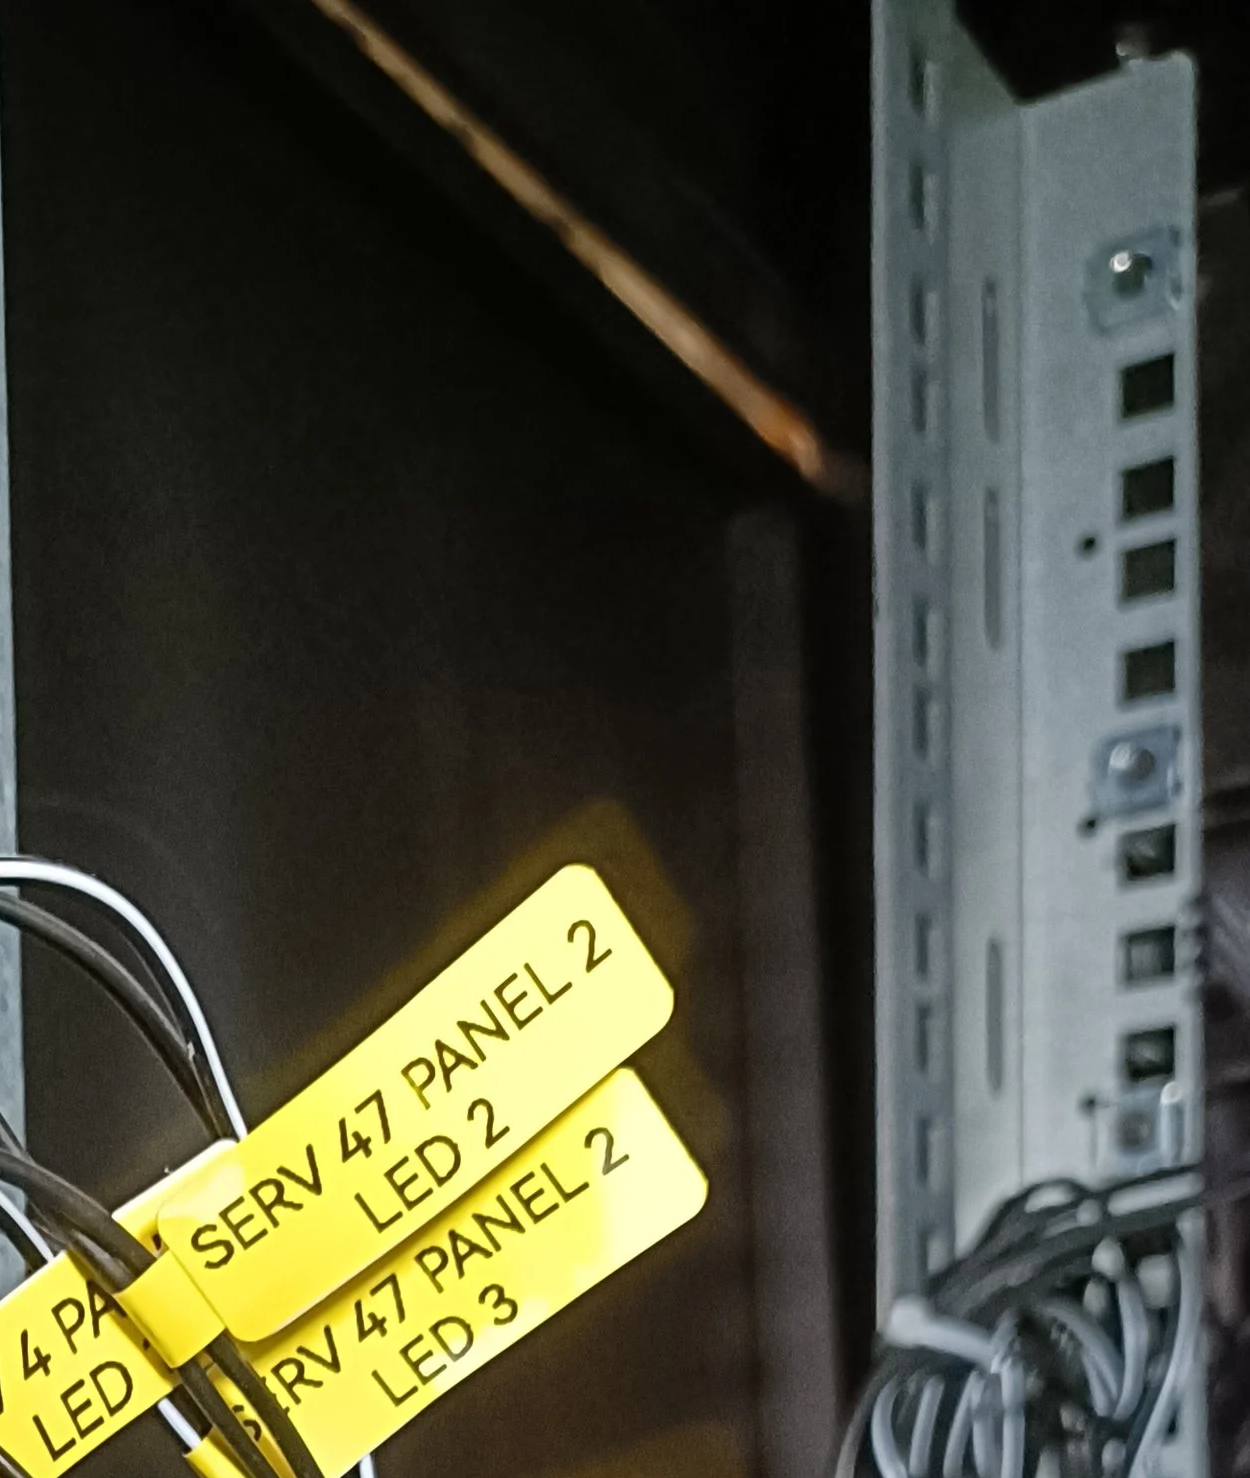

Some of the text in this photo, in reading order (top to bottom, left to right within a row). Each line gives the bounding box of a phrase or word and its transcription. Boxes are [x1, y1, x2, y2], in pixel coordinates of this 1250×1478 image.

[191, 919, 613, 1272] SERV 47 PANEL 2
[354, 1098, 510, 1234] LED 2
[355, 1273, 408, 1343] 47
[416, 1159, 588, 1297] PANEL
[583, 1125, 630, 1177] 2
[20, 1329, 52, 1381] 4
[371, 1283, 519, 1407] LED 3
[32, 1361, 134, 1462] LED
